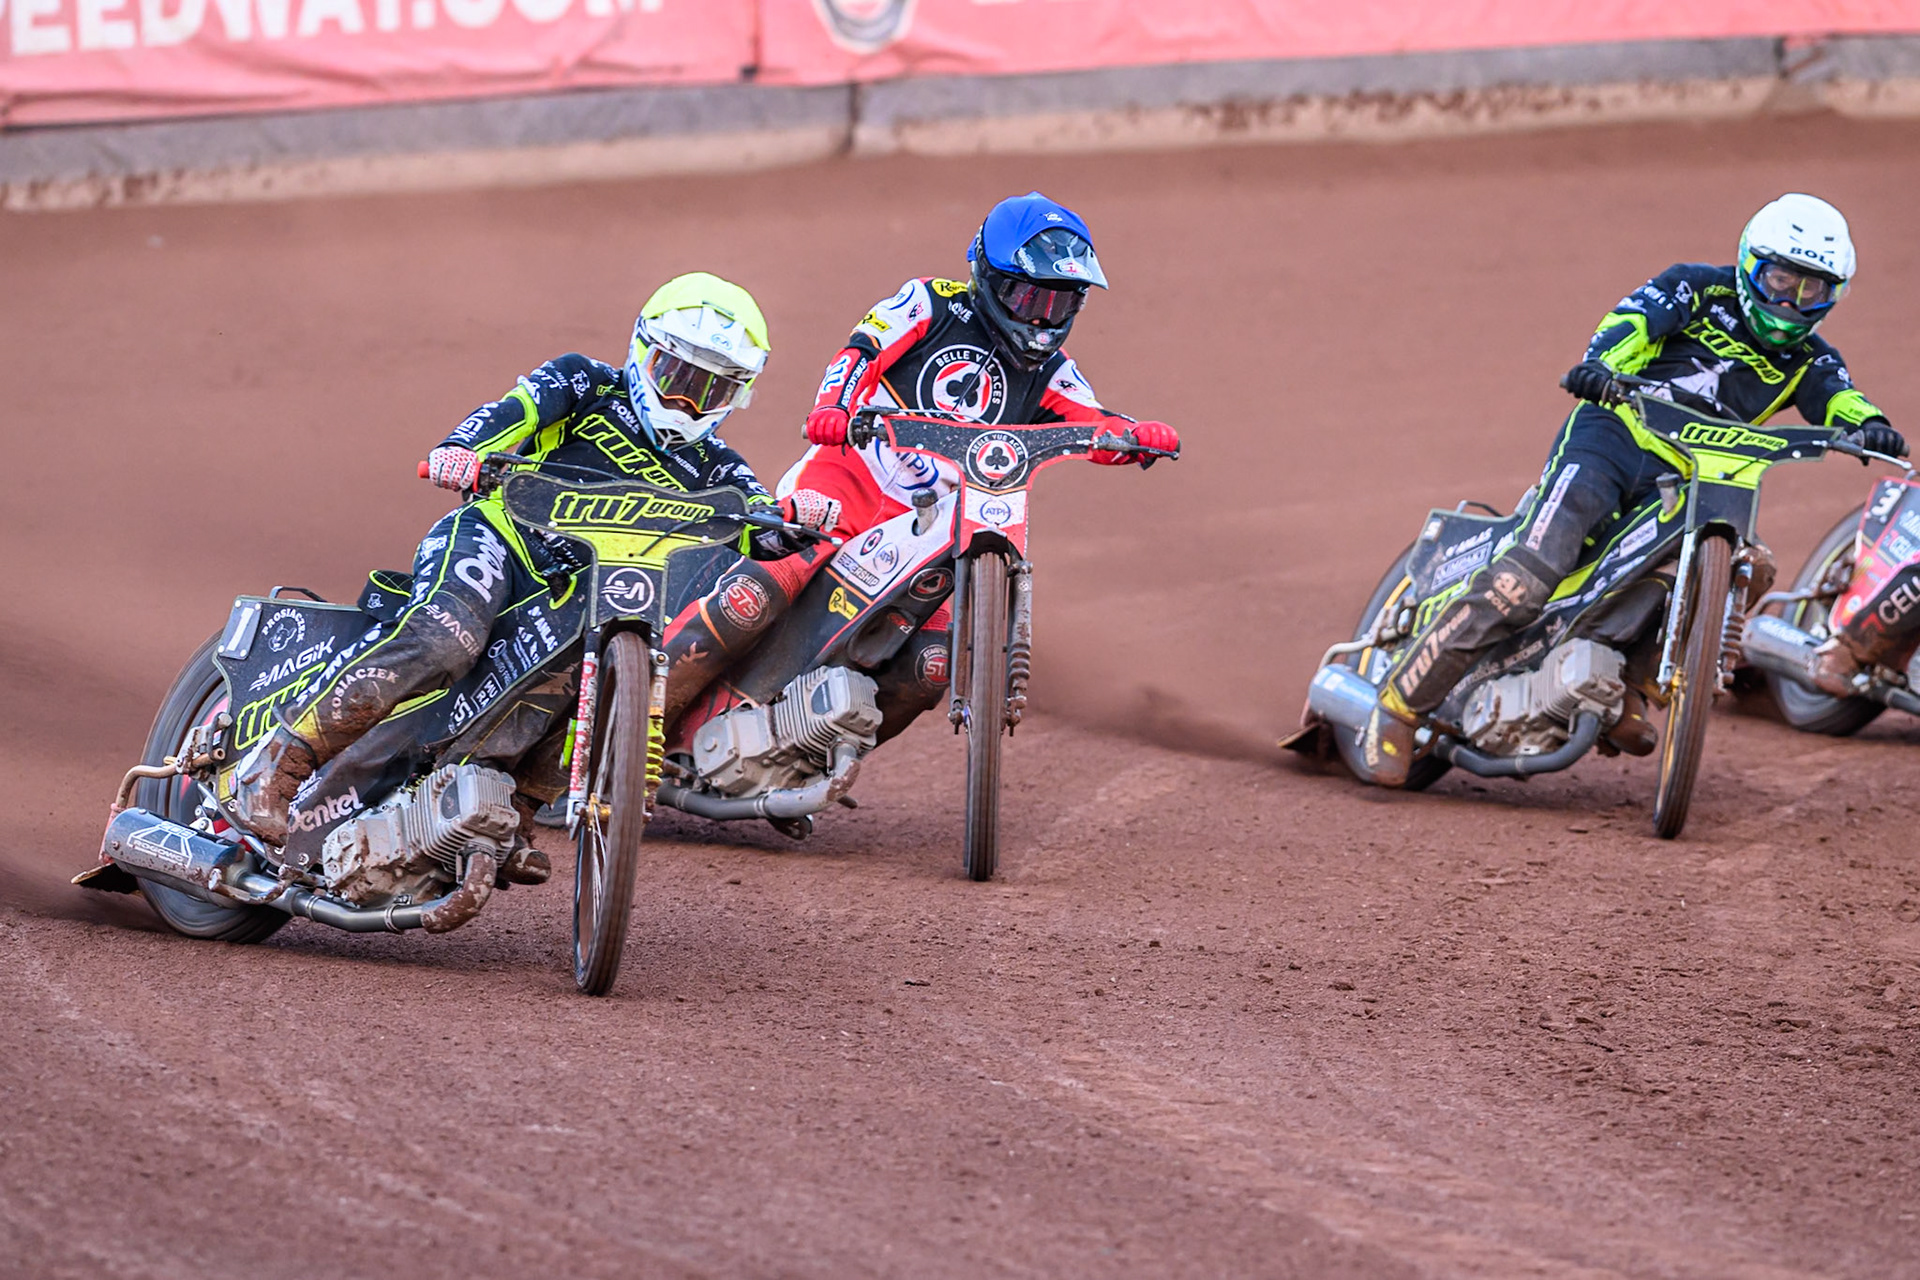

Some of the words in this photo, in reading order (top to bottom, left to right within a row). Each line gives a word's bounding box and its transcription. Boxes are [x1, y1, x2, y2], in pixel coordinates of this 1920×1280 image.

[935, 350, 970, 367] BELLE
[975, 354, 993, 373] VE
[991, 375, 1001, 405] ACES
[971, 434, 990, 454] BELLE
[1008, 434, 1024, 456] ACES
[1871, 488, 1902, 516] 3
[728, 585, 761, 617] STS
[261, 608, 306, 644] PROSIACZEK
[924, 661, 947, 676] ST
